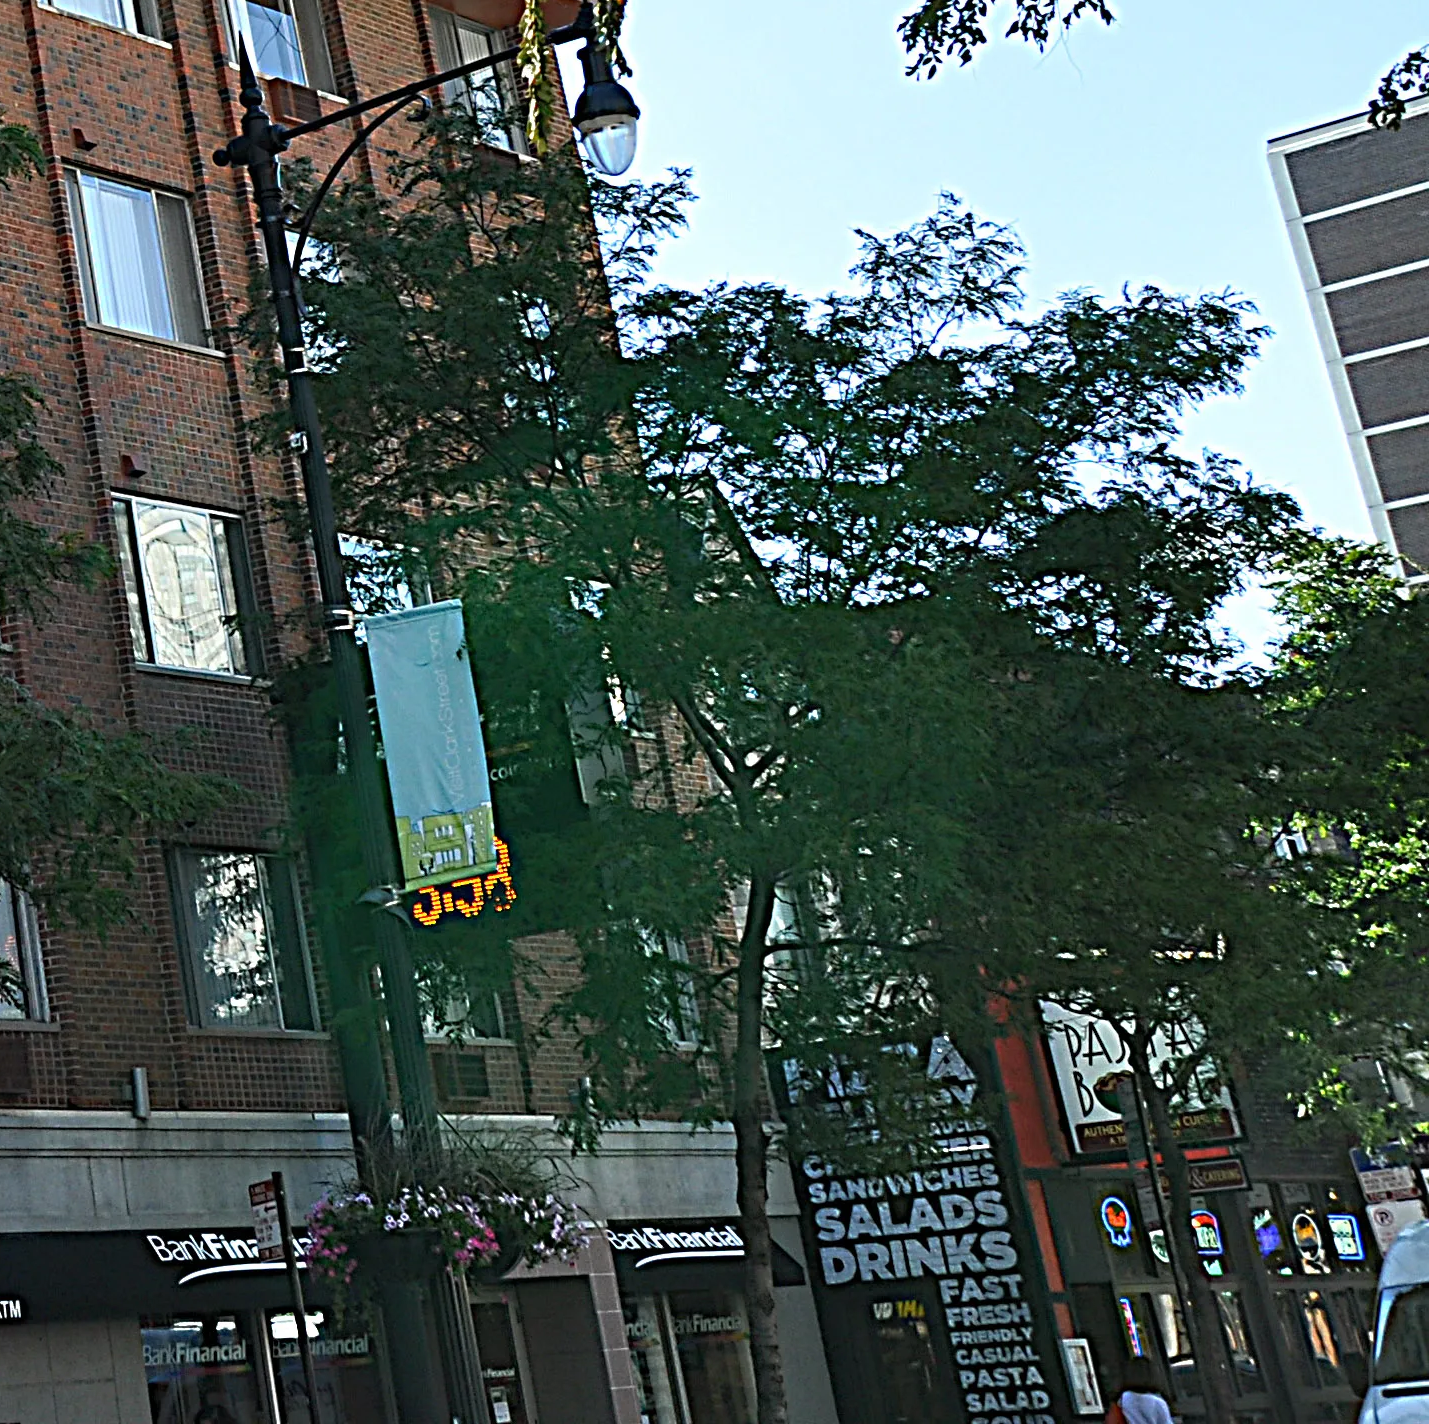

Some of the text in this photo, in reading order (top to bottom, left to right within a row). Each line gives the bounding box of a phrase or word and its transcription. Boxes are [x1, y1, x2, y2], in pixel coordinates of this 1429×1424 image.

[808, 1164, 999, 1204] SANDWICHES
[815, 1190, 1009, 1242] SALADS
[605, 1226, 743, 1250] BankFinancial
[819, 1231, 1017, 1285] DRINKS
[940, 1274, 1022, 1304] FAST
[945, 1302, 1032, 1327] FRESH
[273, 1335, 368, 1359] Baninancial
[950, 1327, 1034, 1346] FRIENDLY
[142, 1339, 247, 1366] BankFinancial
[956, 1346, 1040, 1365] CASUAL
[959, 1366, 1044, 1389] PASTA
[966, 1391, 1050, 1413] SALAD
